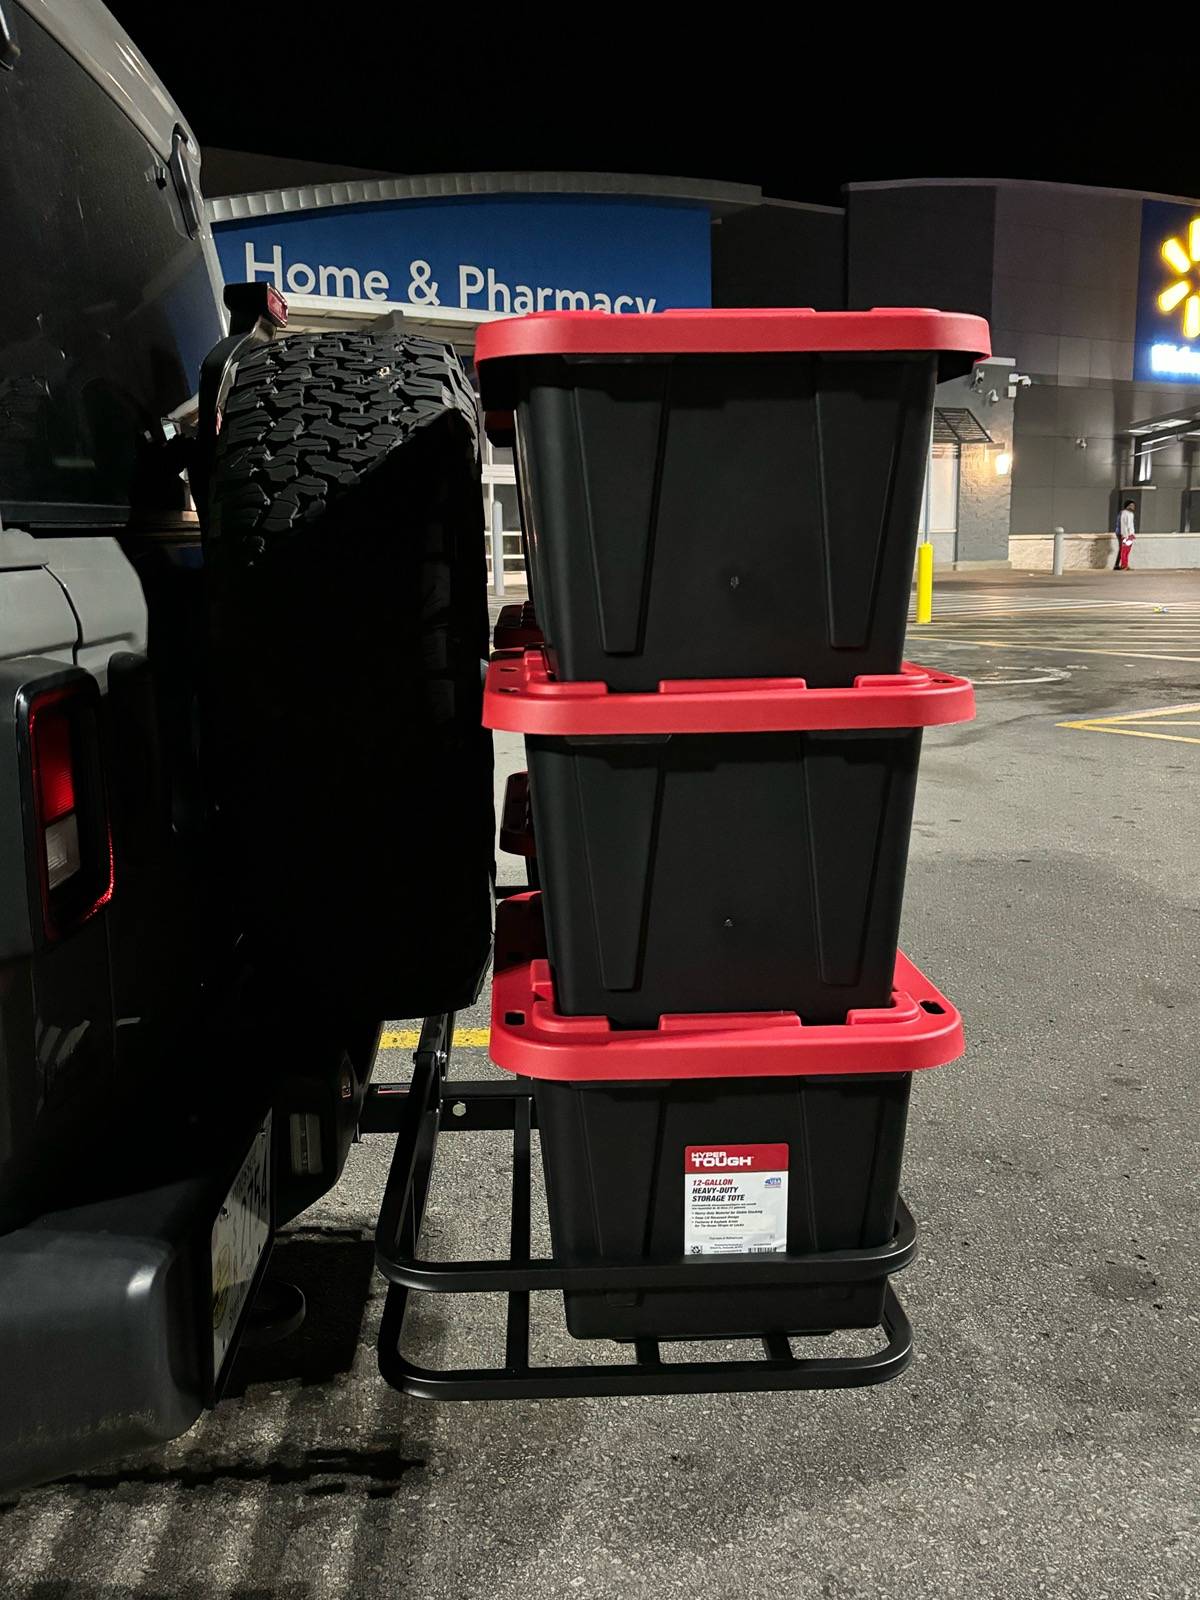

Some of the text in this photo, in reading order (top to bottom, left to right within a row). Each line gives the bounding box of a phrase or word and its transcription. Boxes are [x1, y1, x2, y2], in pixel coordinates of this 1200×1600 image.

[245, 242, 656, 314] Home & Pharmacy
[691, 1156, 752, 1167] TOUGH
[692, 1178, 733, 1186] 12-GALLON
